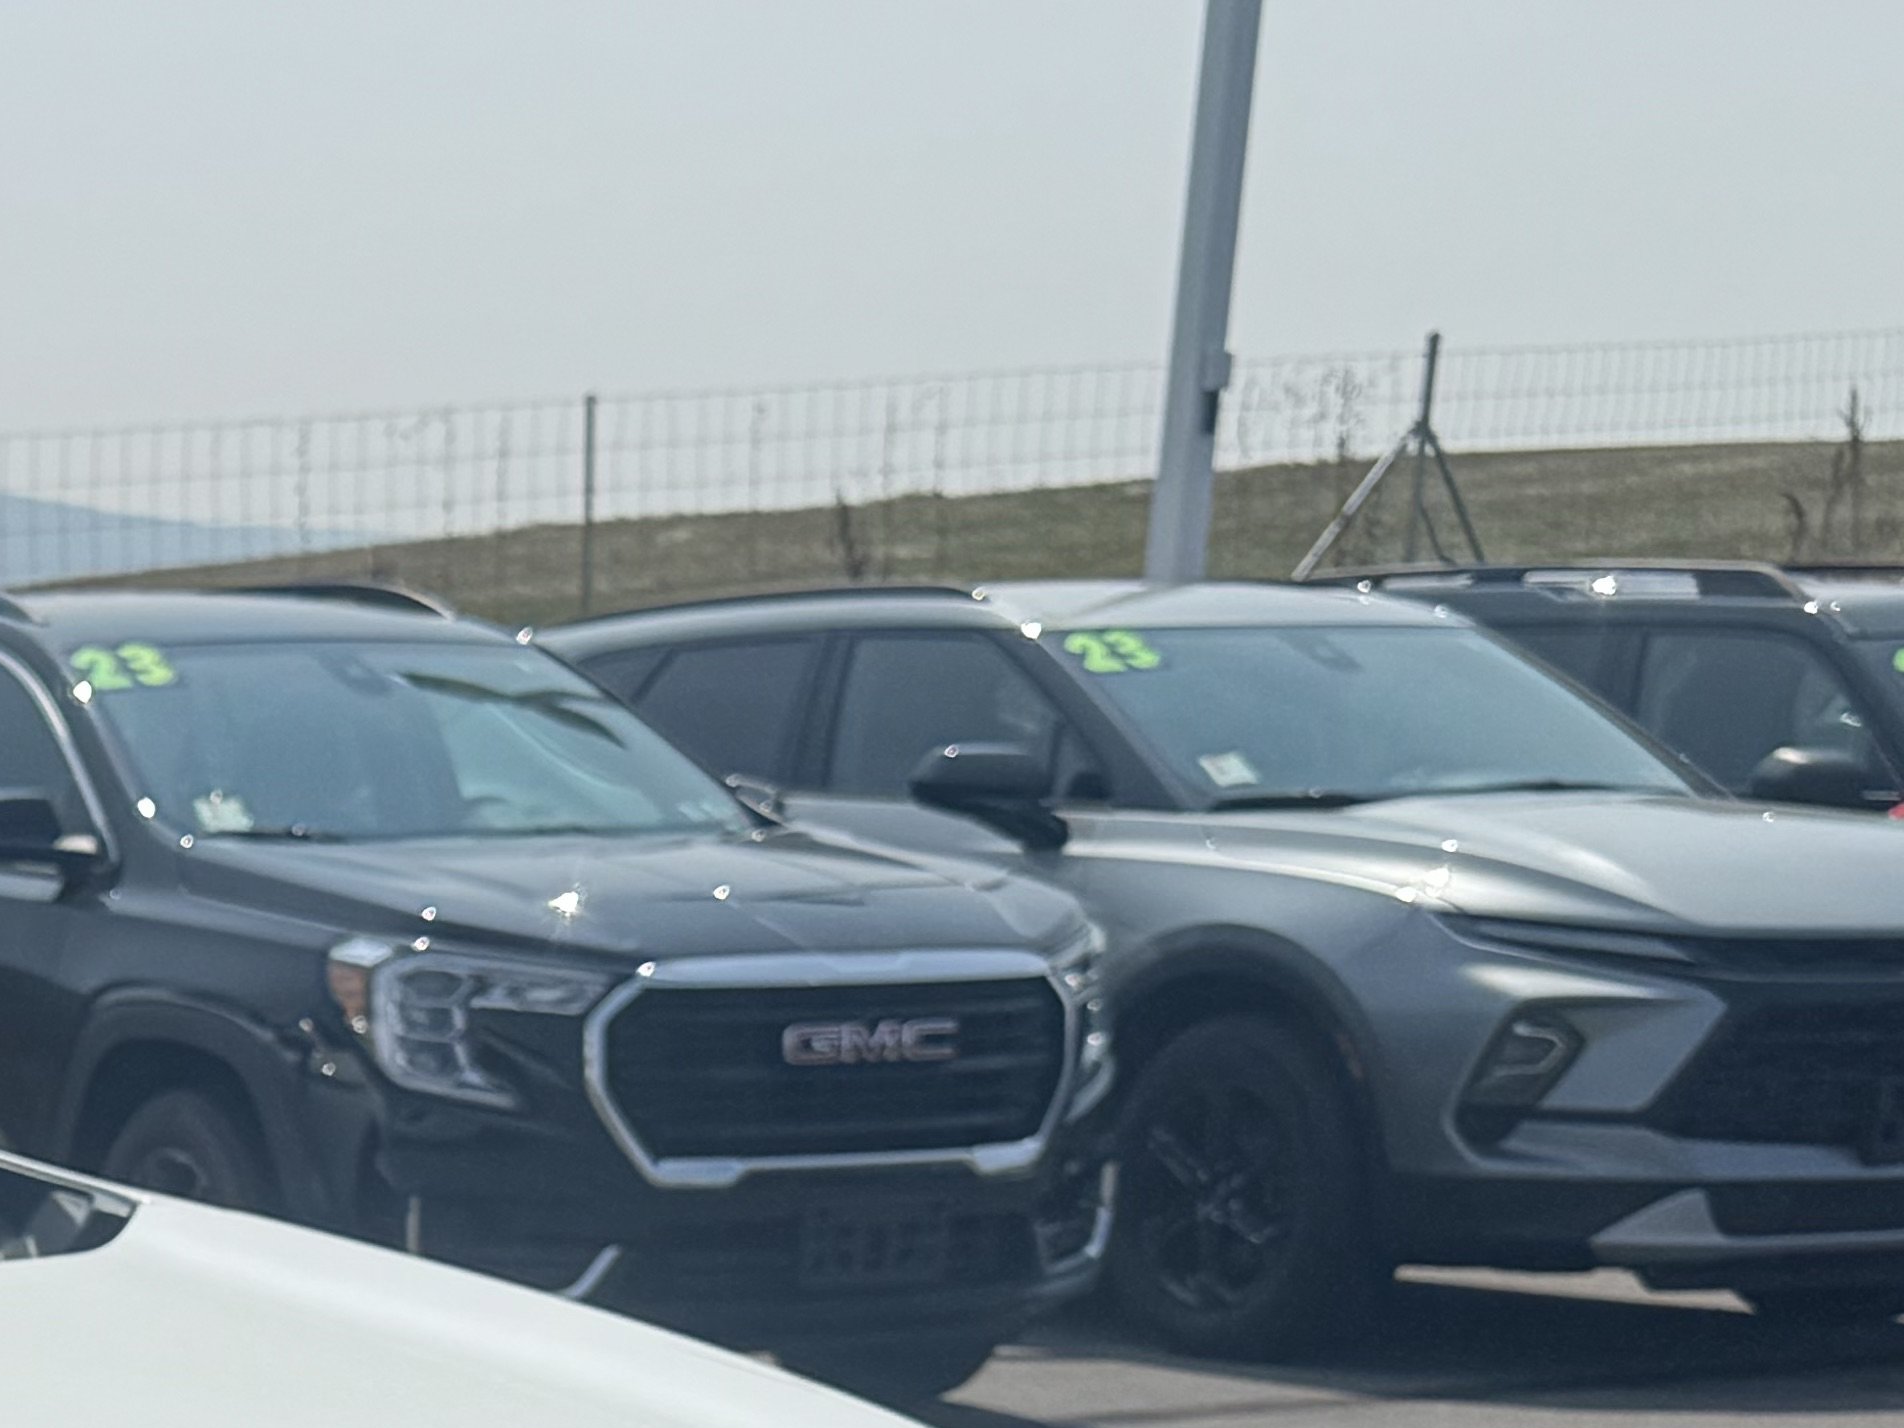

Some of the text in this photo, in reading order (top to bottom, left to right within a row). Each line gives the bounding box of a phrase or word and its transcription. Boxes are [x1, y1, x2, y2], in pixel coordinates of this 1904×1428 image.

[70, 643, 174, 690] 23
[1064, 629, 1161, 673] 23
[782, 1017, 960, 1066] GMC
